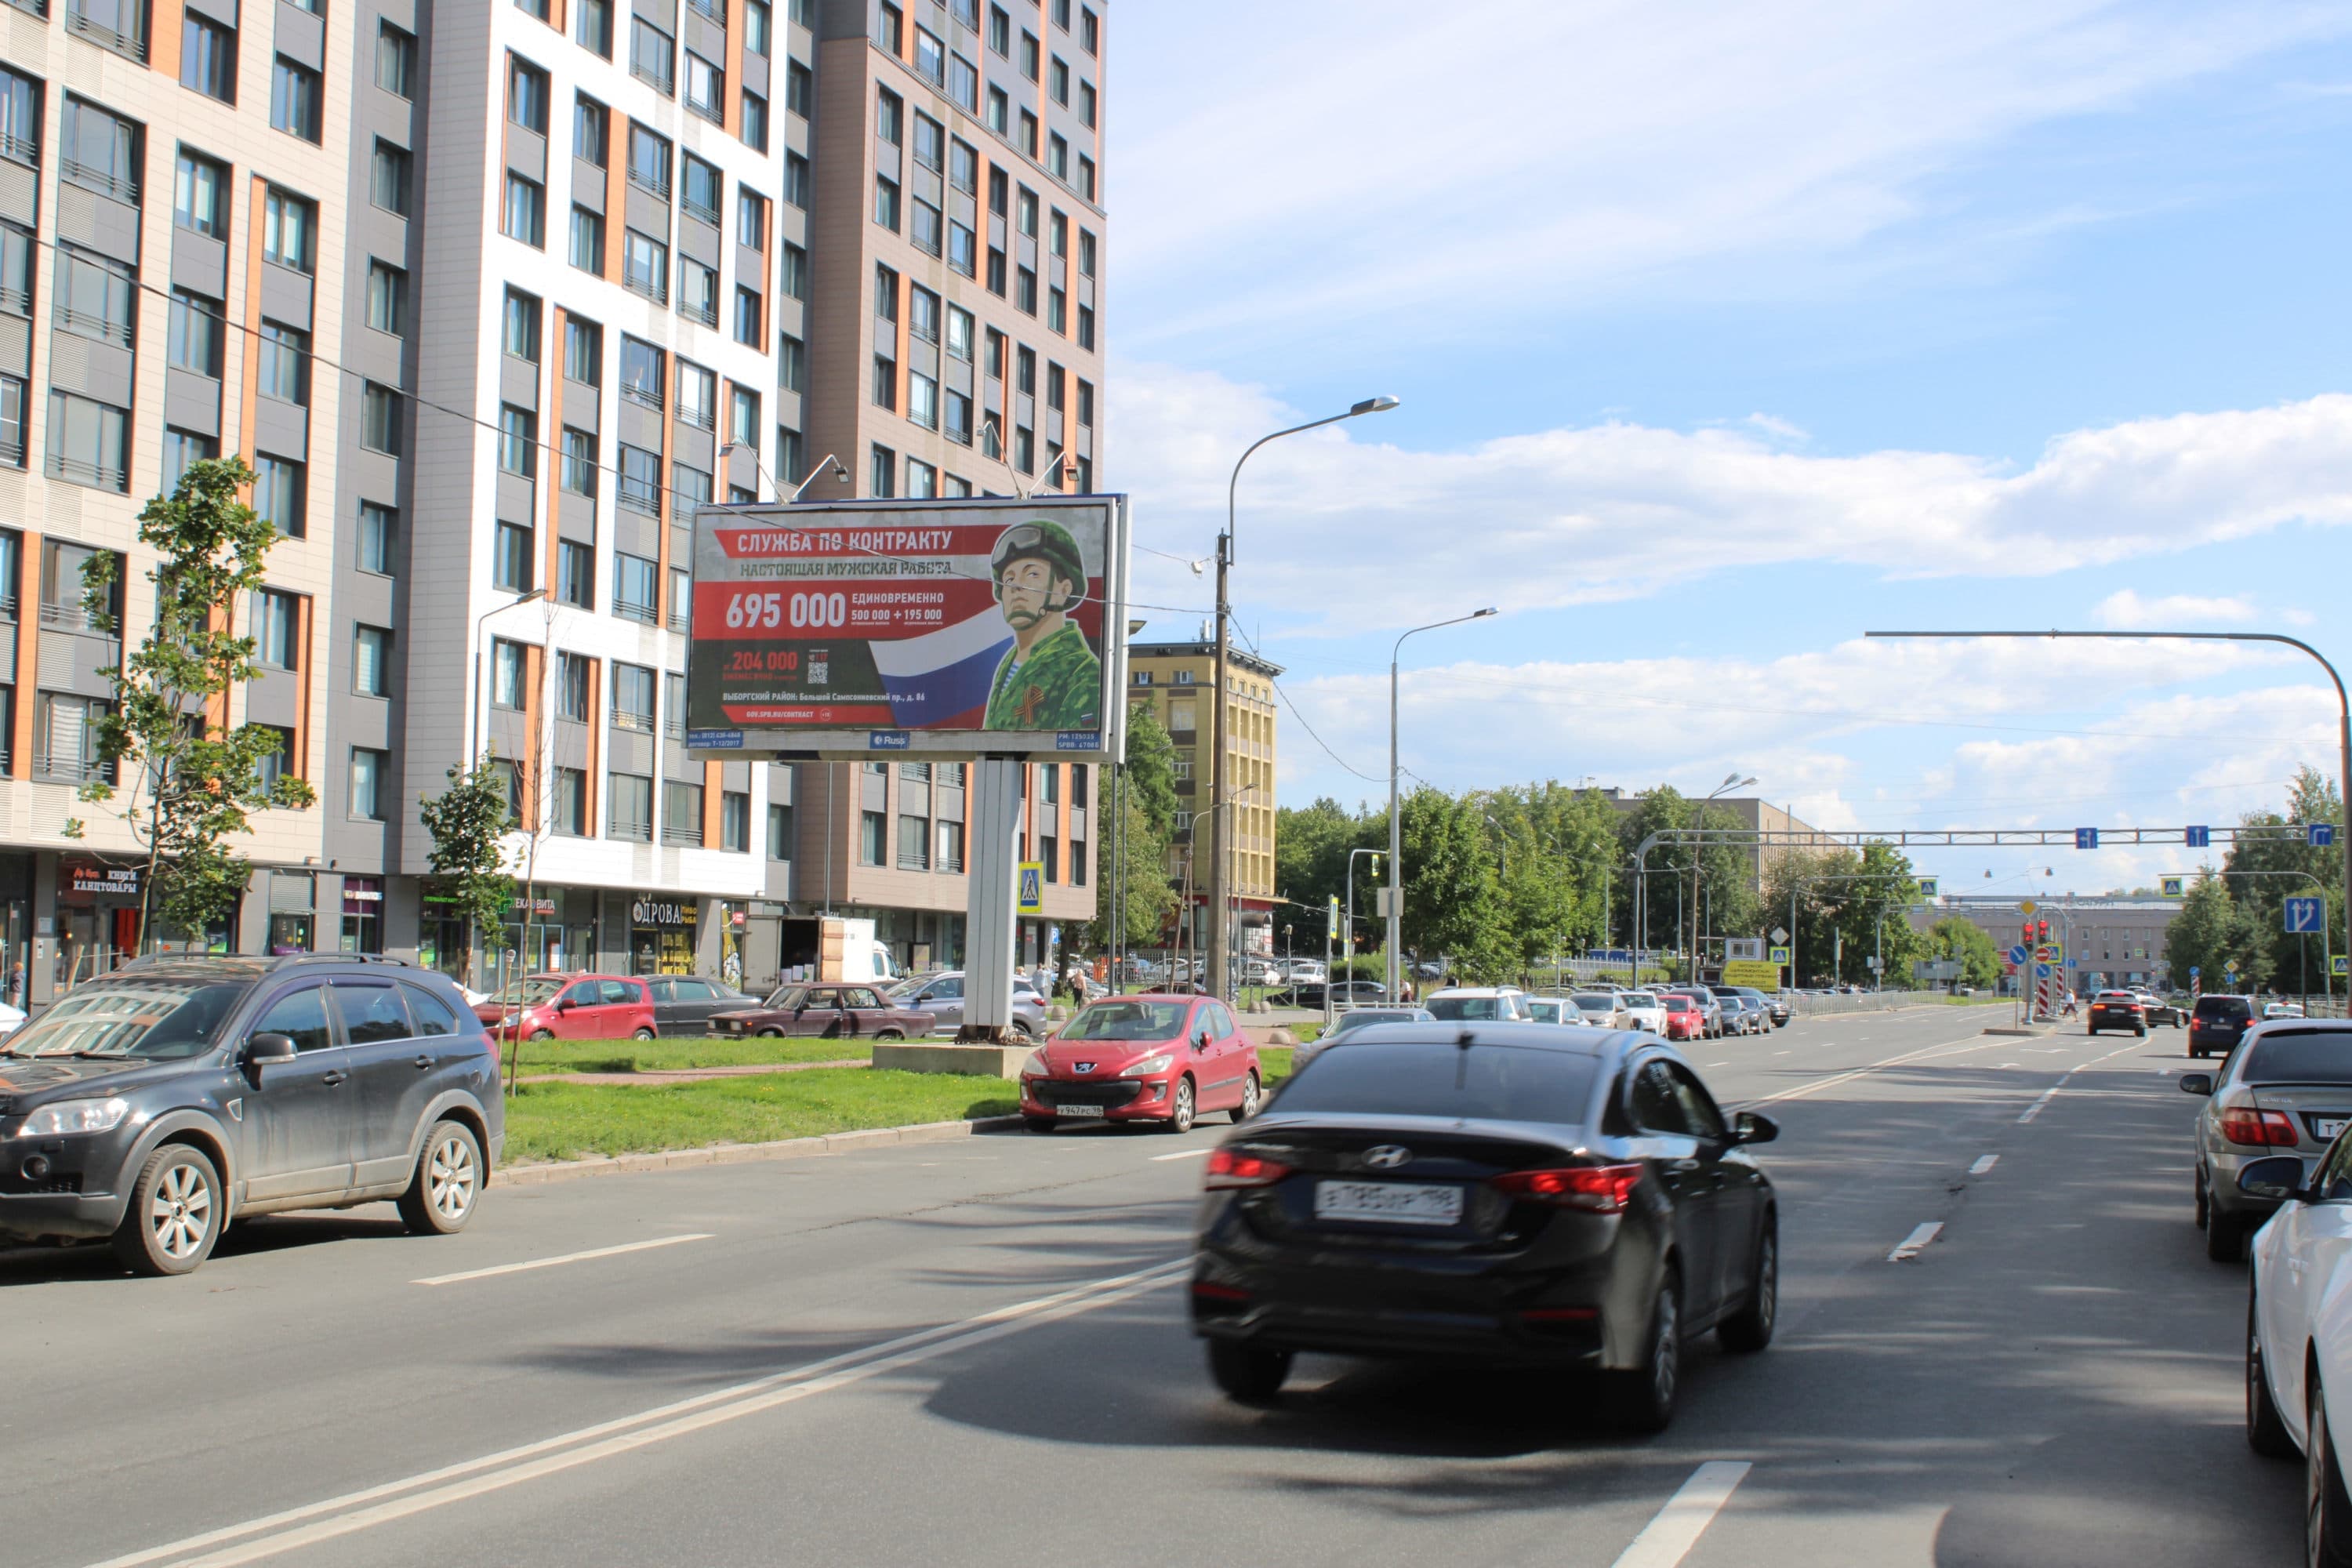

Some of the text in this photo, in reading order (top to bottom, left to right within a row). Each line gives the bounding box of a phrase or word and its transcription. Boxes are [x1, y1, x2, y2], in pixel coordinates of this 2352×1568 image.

[738, 530, 953, 552] СЛУЖБА ПО КОНТРАКТУ
[740, 561, 952, 576] НАСТОЯЩАЯ МУЖСКАЯ РАБОТА
[851, 593, 944, 605] ЕДИНОВРЕМЕННО
[726, 592, 845, 627] 695 000
[851, 609, 869, 620] 500
[872, 609, 890, 620] 000
[904, 609, 922, 620] 195
[924, 609, 942, 620] 000
[732, 652, 763, 670] 204
[767, 652, 798, 670] 000
[723, 691, 770, 701] ВЫБОРГСКИЙ
[771, 691, 798, 701] РАЙОН:
[800, 692, 830, 701] Большой
[884, 735, 906, 745] Russ
[73, 880, 137, 893] КАНЦТОВАРЫ
[536, 898, 555, 909] ВИТА
